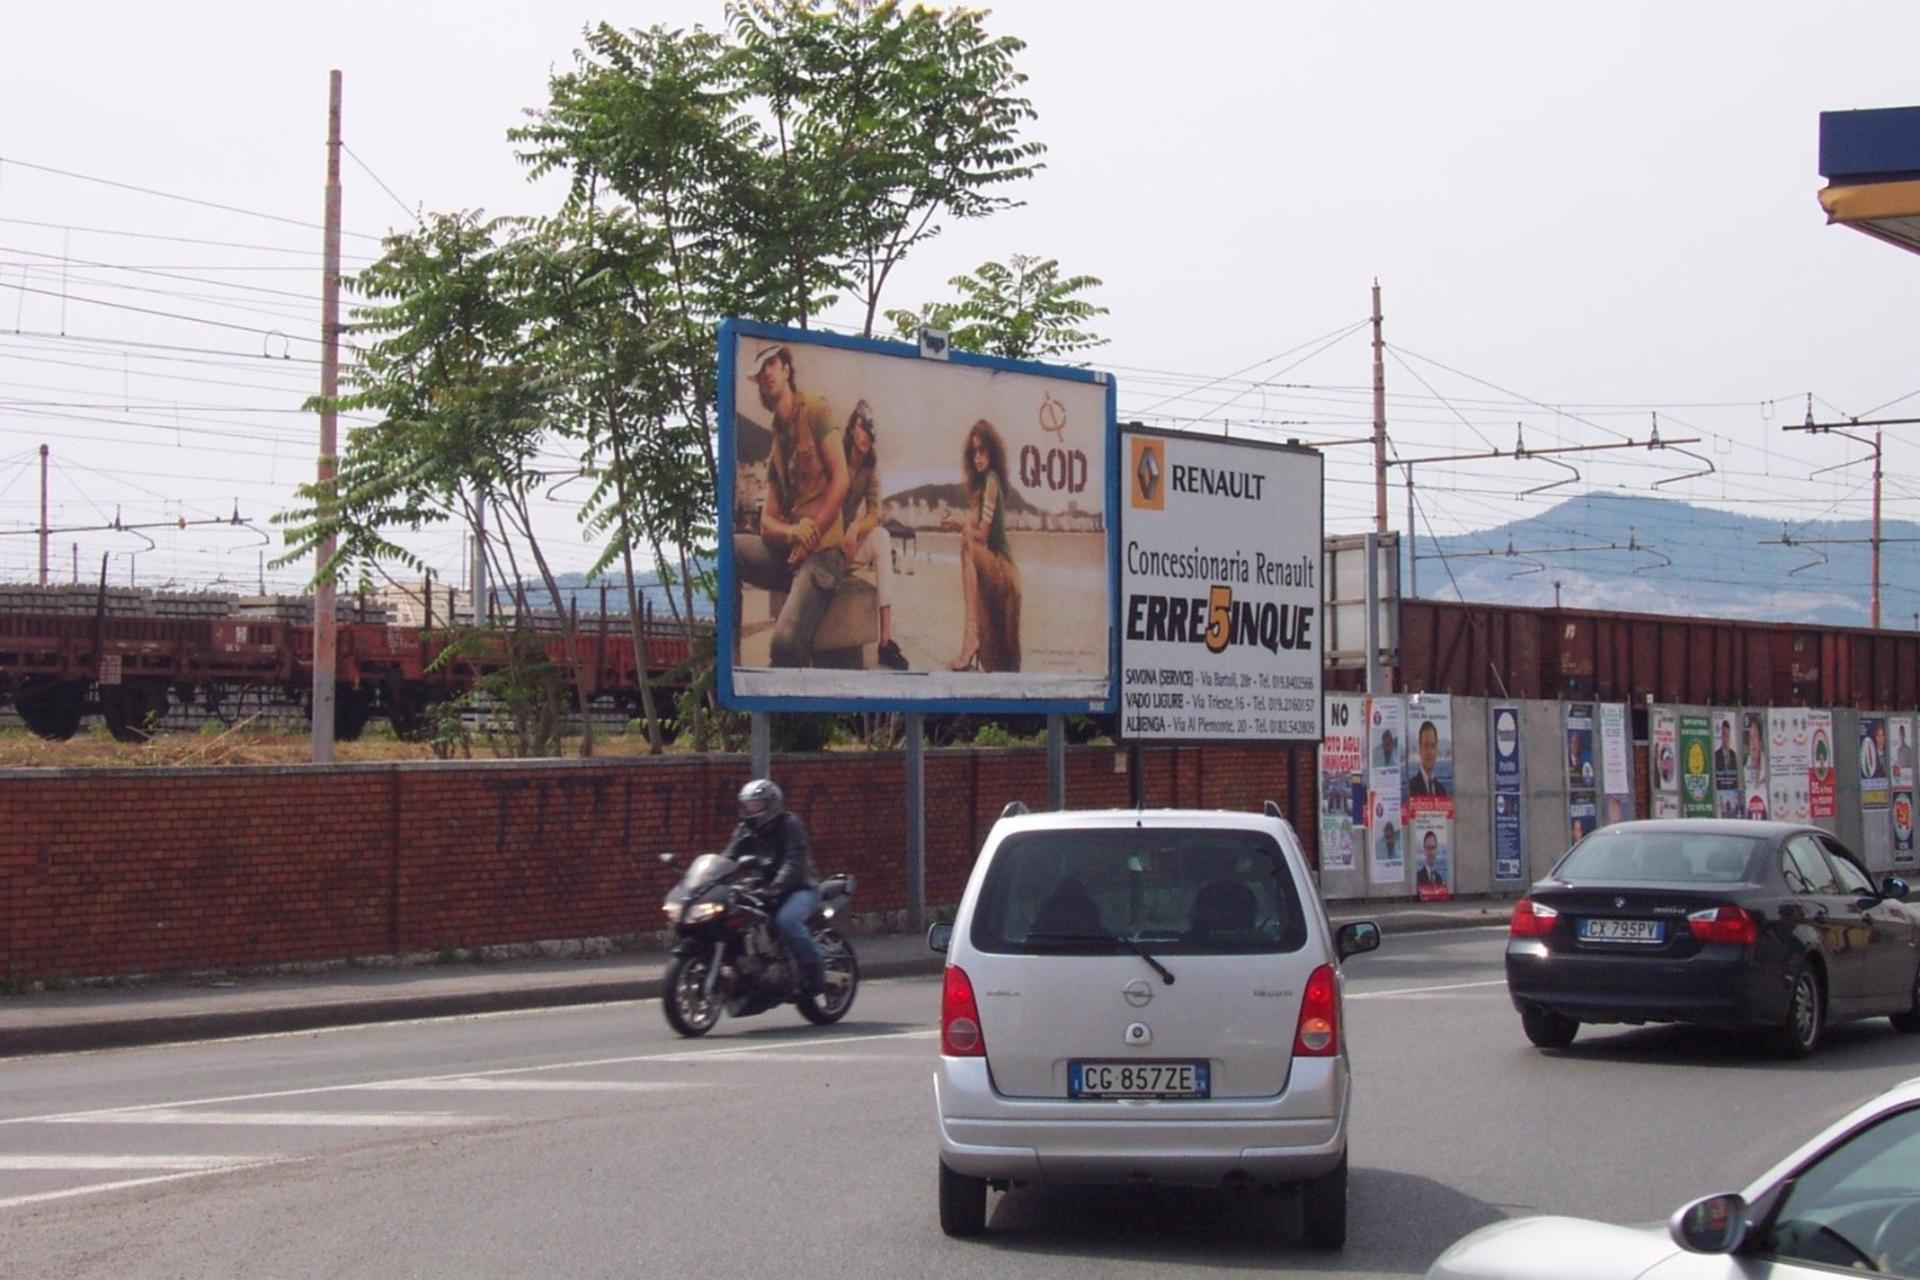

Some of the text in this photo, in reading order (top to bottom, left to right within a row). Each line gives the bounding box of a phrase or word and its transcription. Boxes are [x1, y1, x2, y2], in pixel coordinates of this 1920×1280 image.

[1172, 464, 1265, 500] RENAULT
[1127, 540, 1314, 588] Concessionaria Renault
[1126, 585, 1314, 655] ERRE5INQUE
[1125, 668, 1157, 685] SAVONA
[1200, 671, 1212, 686] Via
[1125, 692, 1151, 709] VADO
[1153, 693, 1184, 709] LIGURE
[1192, 694, 1205, 709] Via
[1125, 716, 1166, 732] ALBENGA
[1173, 716, 1186, 732] Via
[1331, 702, 1349, 728] NO
[1589, 921, 1656, 938] CX 795PV
[1085, 1067, 1112, 1090] CG
[1120, 1067, 1192, 1090] 857ZE
